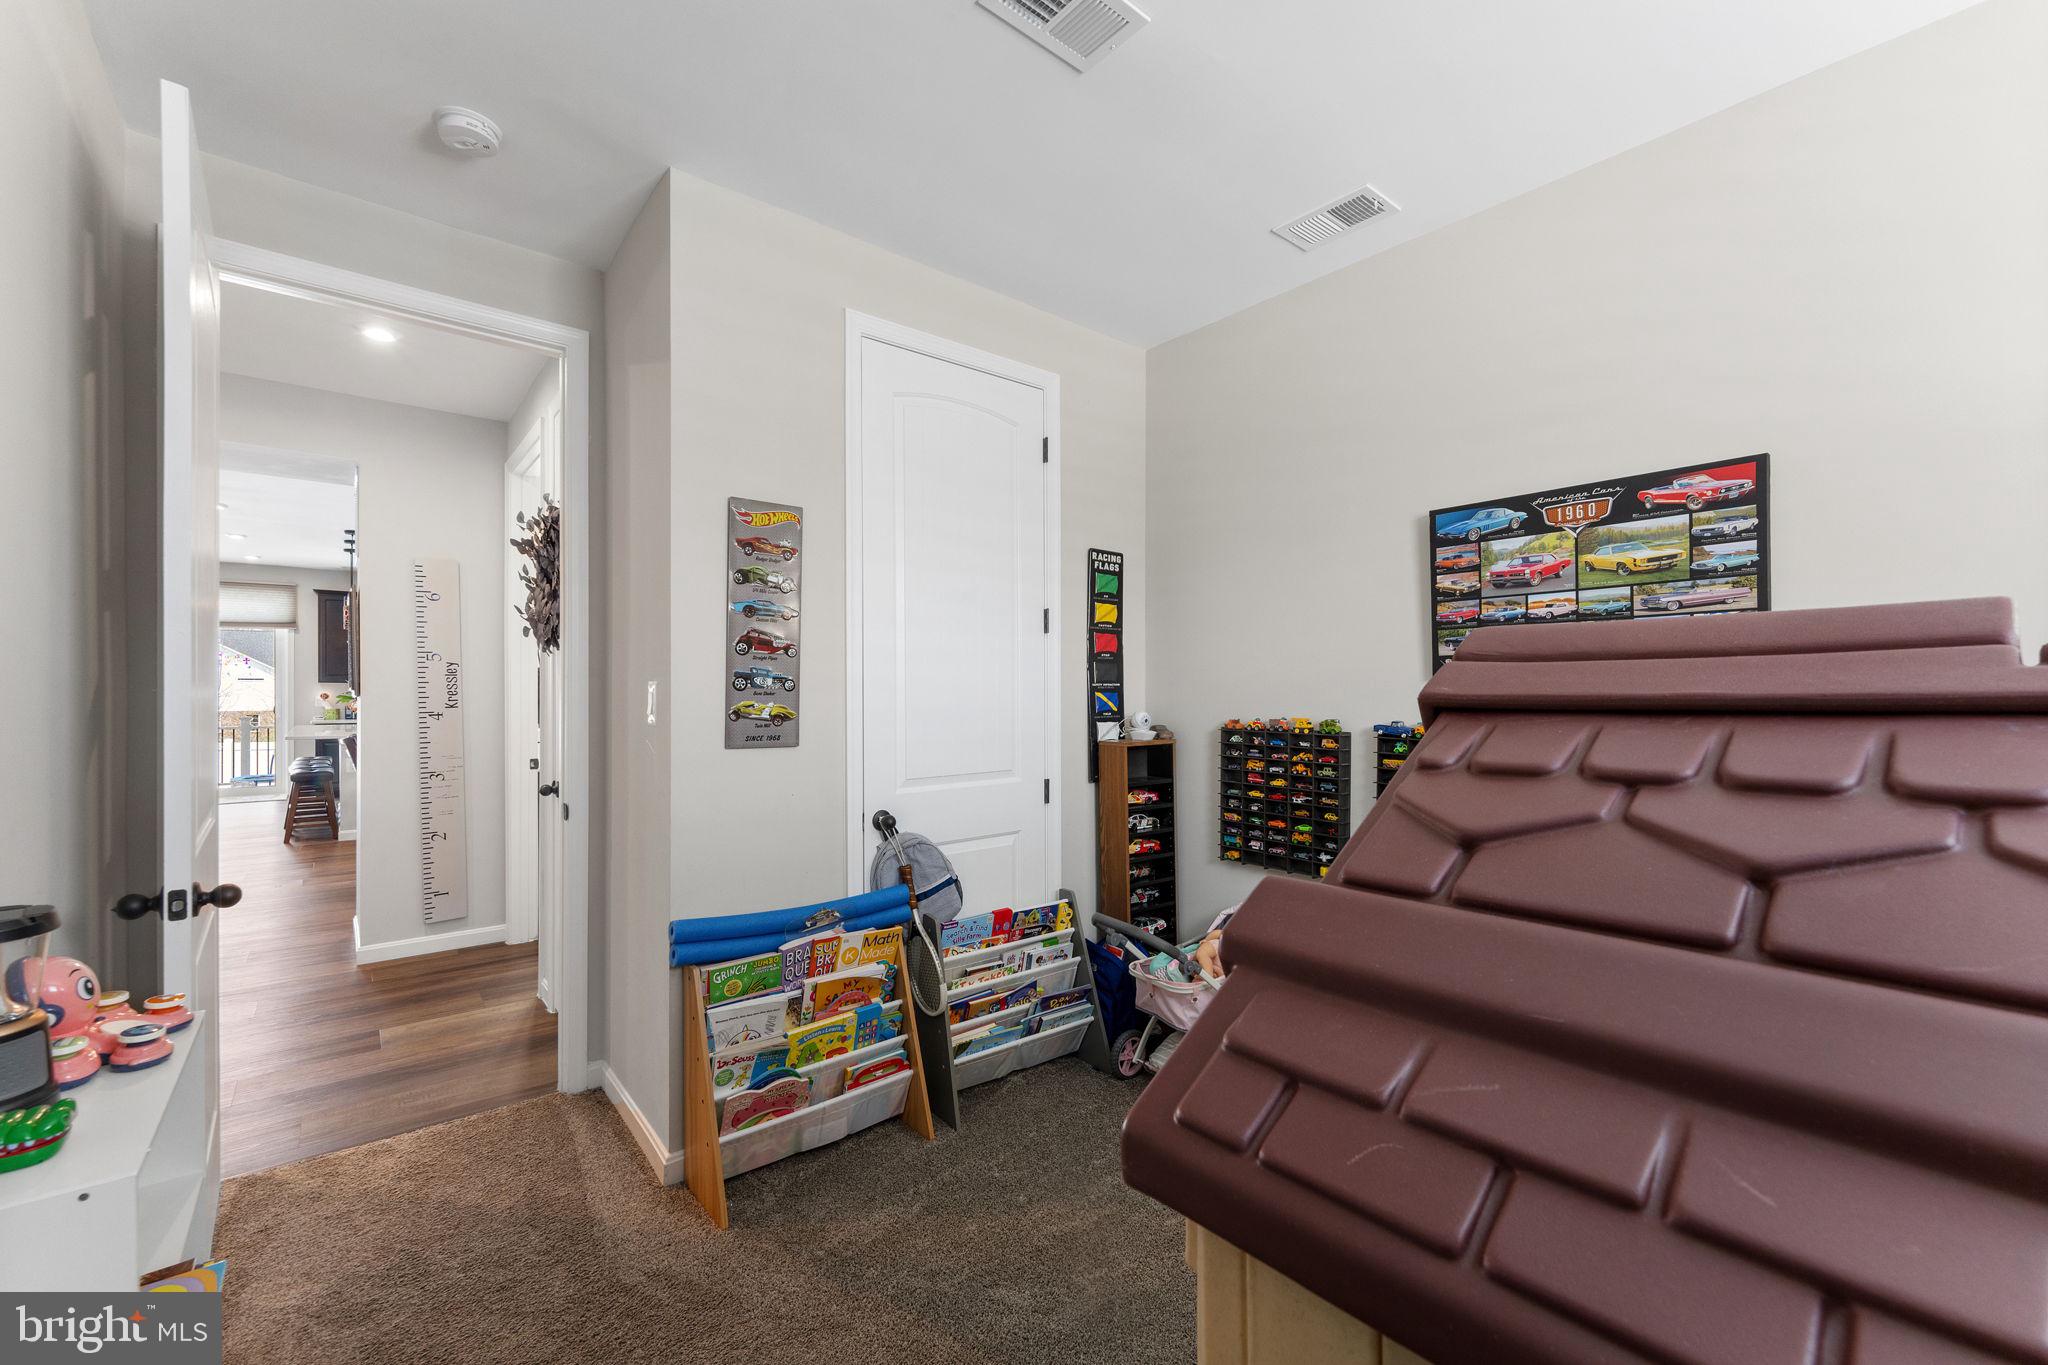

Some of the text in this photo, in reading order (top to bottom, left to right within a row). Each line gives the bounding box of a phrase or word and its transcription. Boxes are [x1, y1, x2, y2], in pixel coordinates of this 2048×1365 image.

[1532, 486, 1623, 505] American Cars
[1557, 502, 1597, 522] 1960
[751, 513, 769, 526] HOT
[1092, 551, 1122, 564] RACING
[1094, 561, 1120, 572] FLAGS
[424, 592, 441, 602] 6
[426, 653, 442, 662] 5
[444, 661, 460, 709] Kressley
[428, 711, 443, 721] 4
[429, 773, 445, 781] 3
[431, 831, 447, 841] 2
[863, 931, 900, 948] Math
[786, 945, 811, 967] BRA
[845, 949, 855, 960] K
[860, 946, 895, 960] Made
[753, 956, 779, 968] JUMBO
[713, 964, 748, 984] GRINCH
[803, 1030, 822, 1042] Listen
[826, 1024, 841, 1034] Learn
